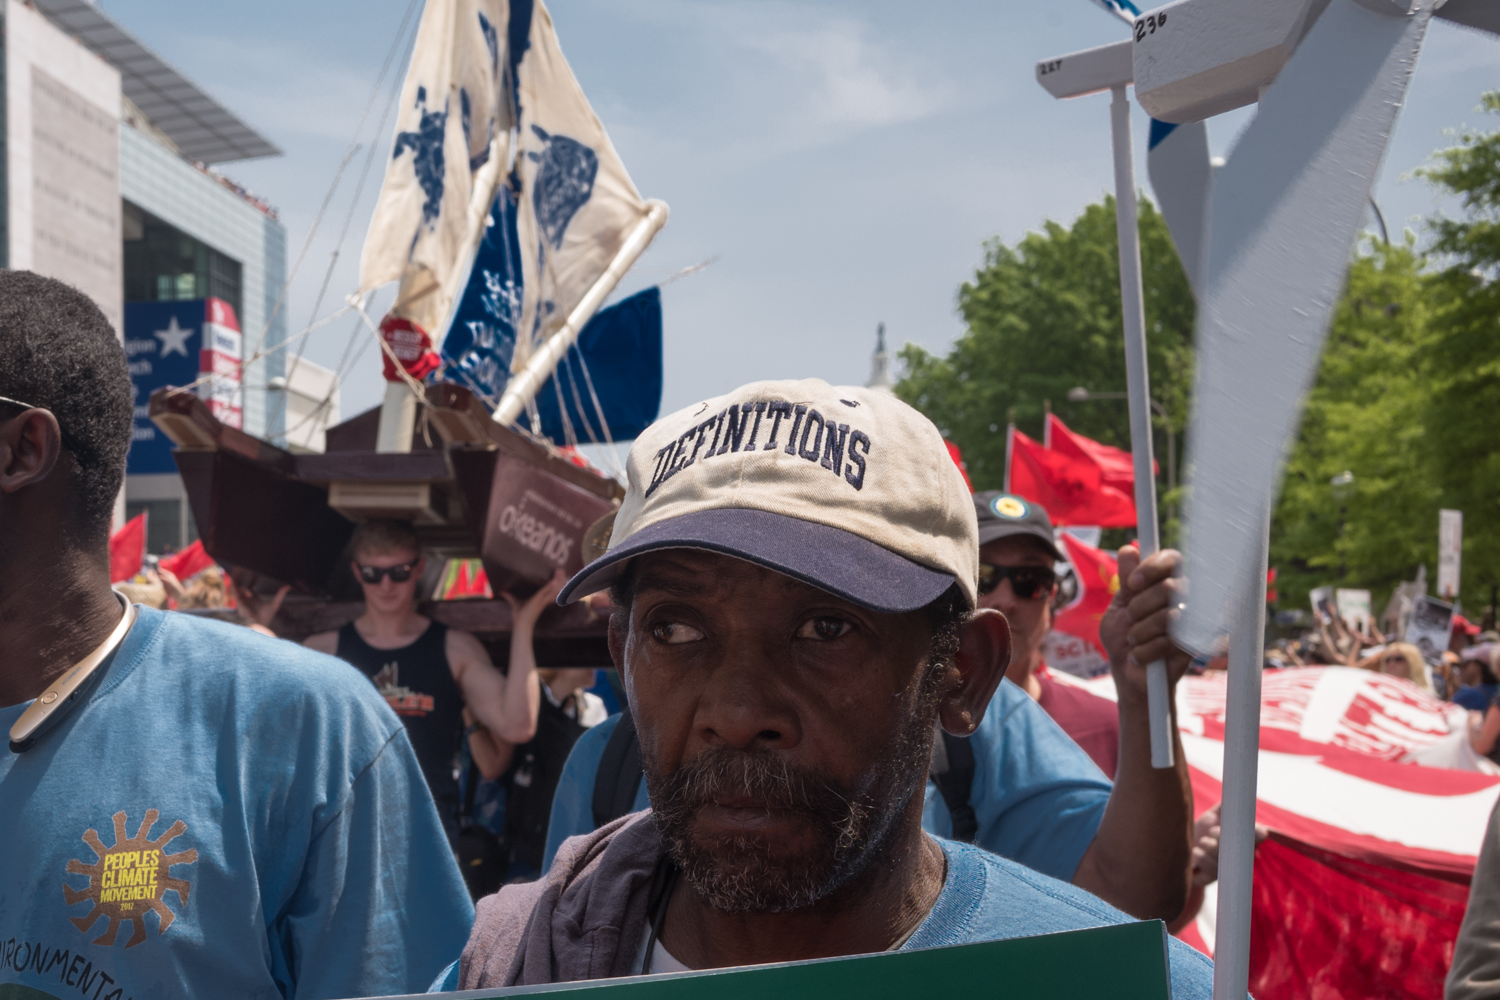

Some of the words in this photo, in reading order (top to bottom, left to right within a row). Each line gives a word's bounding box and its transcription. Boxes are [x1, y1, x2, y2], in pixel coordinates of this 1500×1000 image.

[1134, 12, 1168, 43] 236
[645, 401, 871, 491] DEFINITIONS
[104, 849, 160, 871] PEOPLES
[101, 867, 159, 889] CLIMATE
[100, 885, 159, 903] MOVEMENT
[120, 902, 134, 911] 2017
